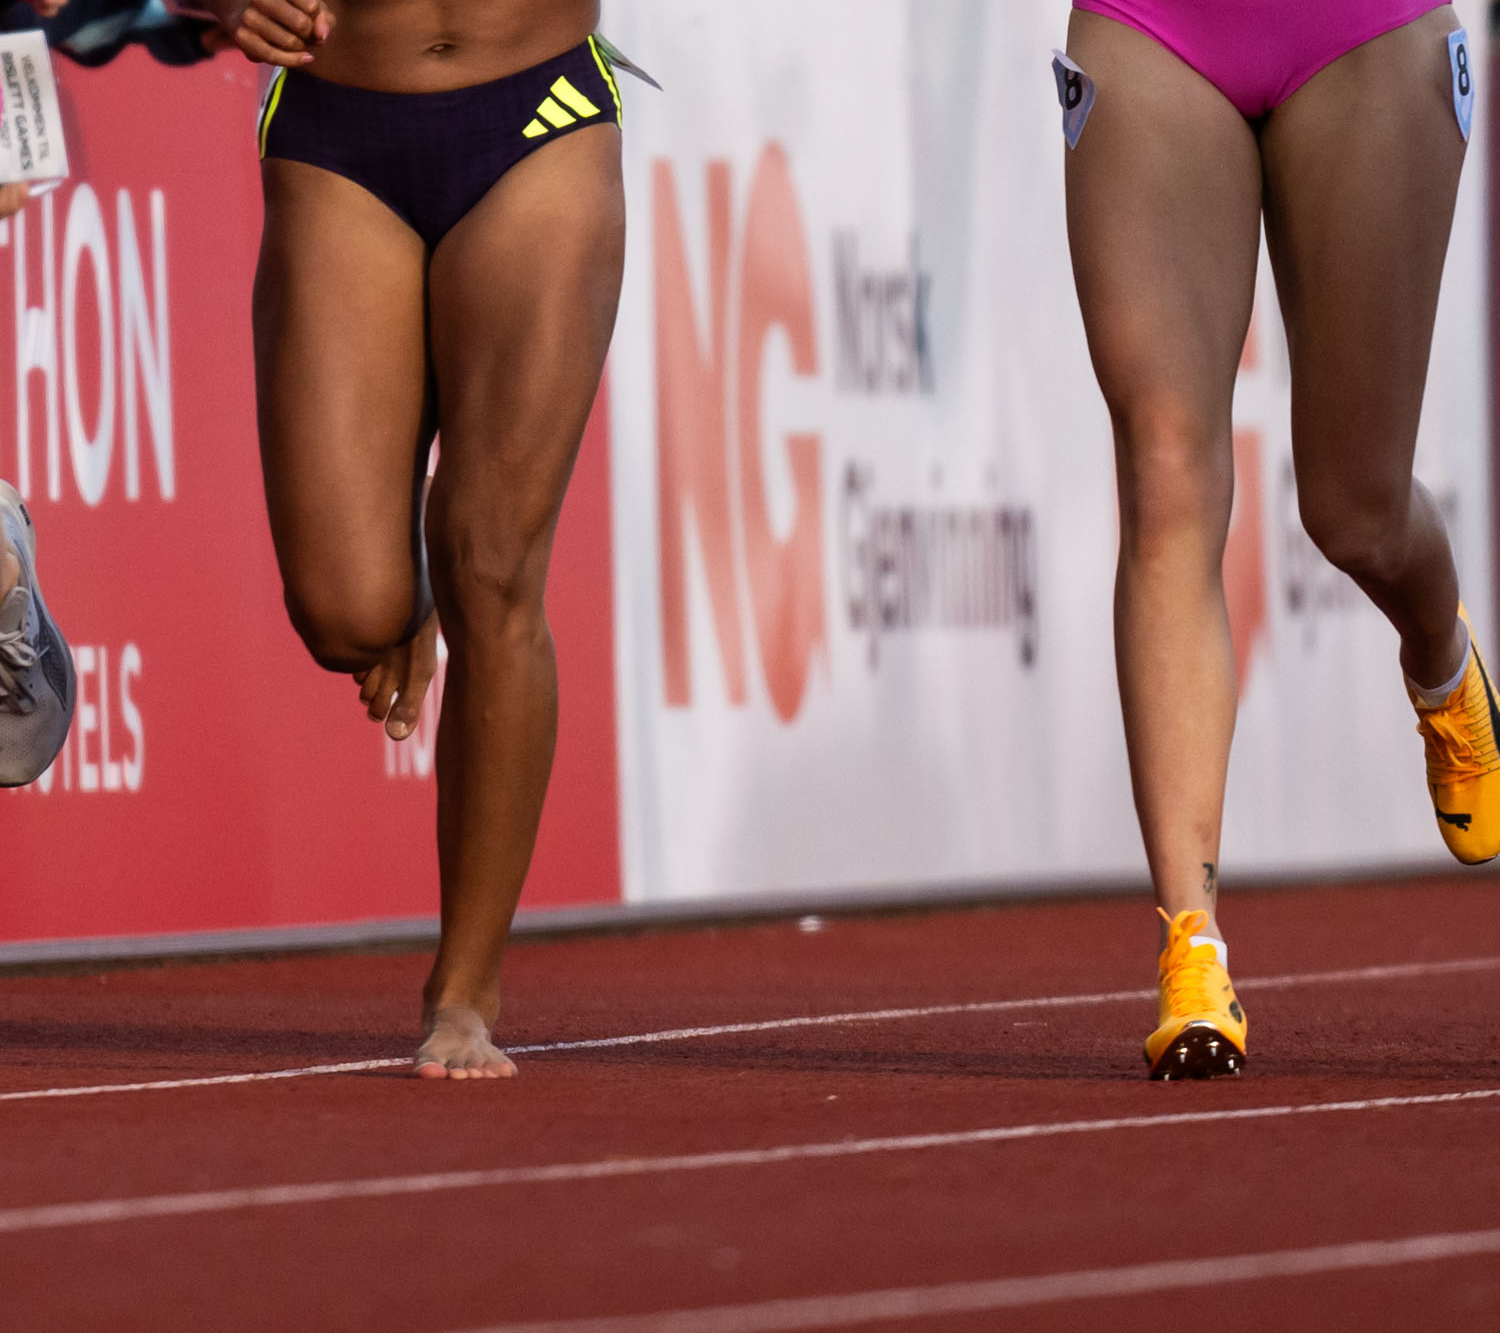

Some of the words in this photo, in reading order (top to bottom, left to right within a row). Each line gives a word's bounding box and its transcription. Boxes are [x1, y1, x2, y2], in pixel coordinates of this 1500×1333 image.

[1455, 43, 1470, 97] 8
[13, 113, 33, 172] GAMES
[650, 139, 829, 725] NG
